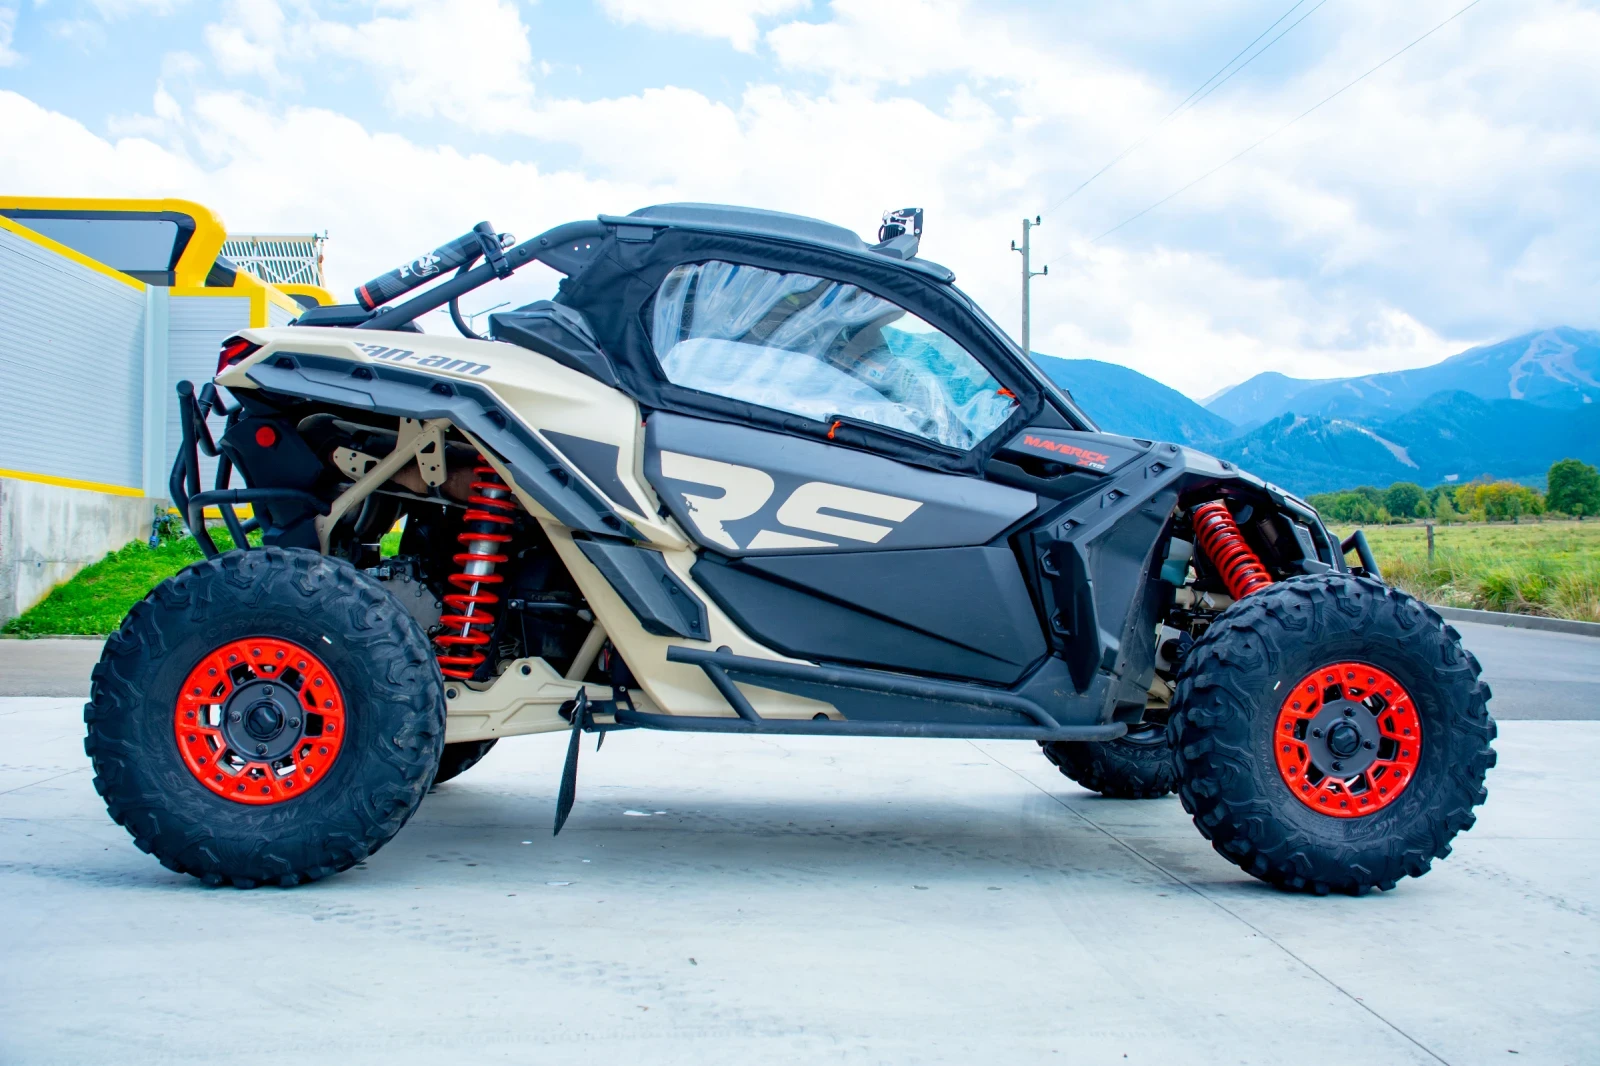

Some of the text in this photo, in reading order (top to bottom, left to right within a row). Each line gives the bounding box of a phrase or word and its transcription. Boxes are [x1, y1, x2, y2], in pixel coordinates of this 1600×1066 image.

[398, 254, 441, 279] FOX
[354, 342, 491, 375] an-am
[1023, 435, 1110, 464] MAVERICK
[660, 450, 924, 550] RS
